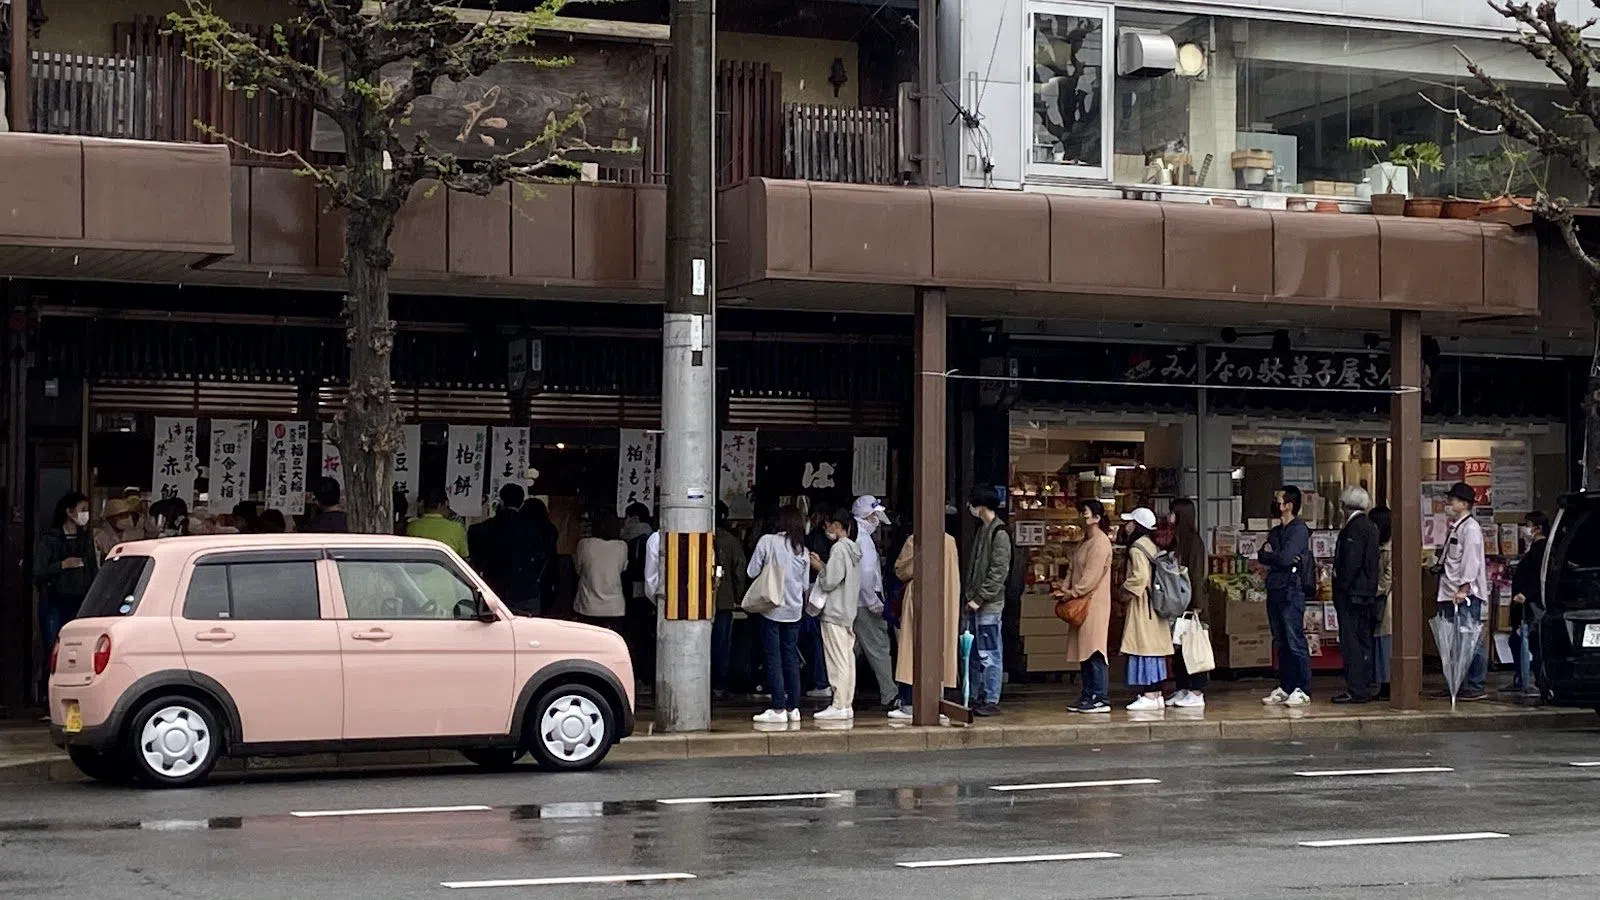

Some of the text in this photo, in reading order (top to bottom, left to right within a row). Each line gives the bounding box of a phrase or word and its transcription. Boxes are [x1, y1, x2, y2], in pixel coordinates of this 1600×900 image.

[160, 456, 181, 500] 赤飯
[221, 443, 237, 498] 田舎大福
[454, 443, 474, 497] 柏餅
